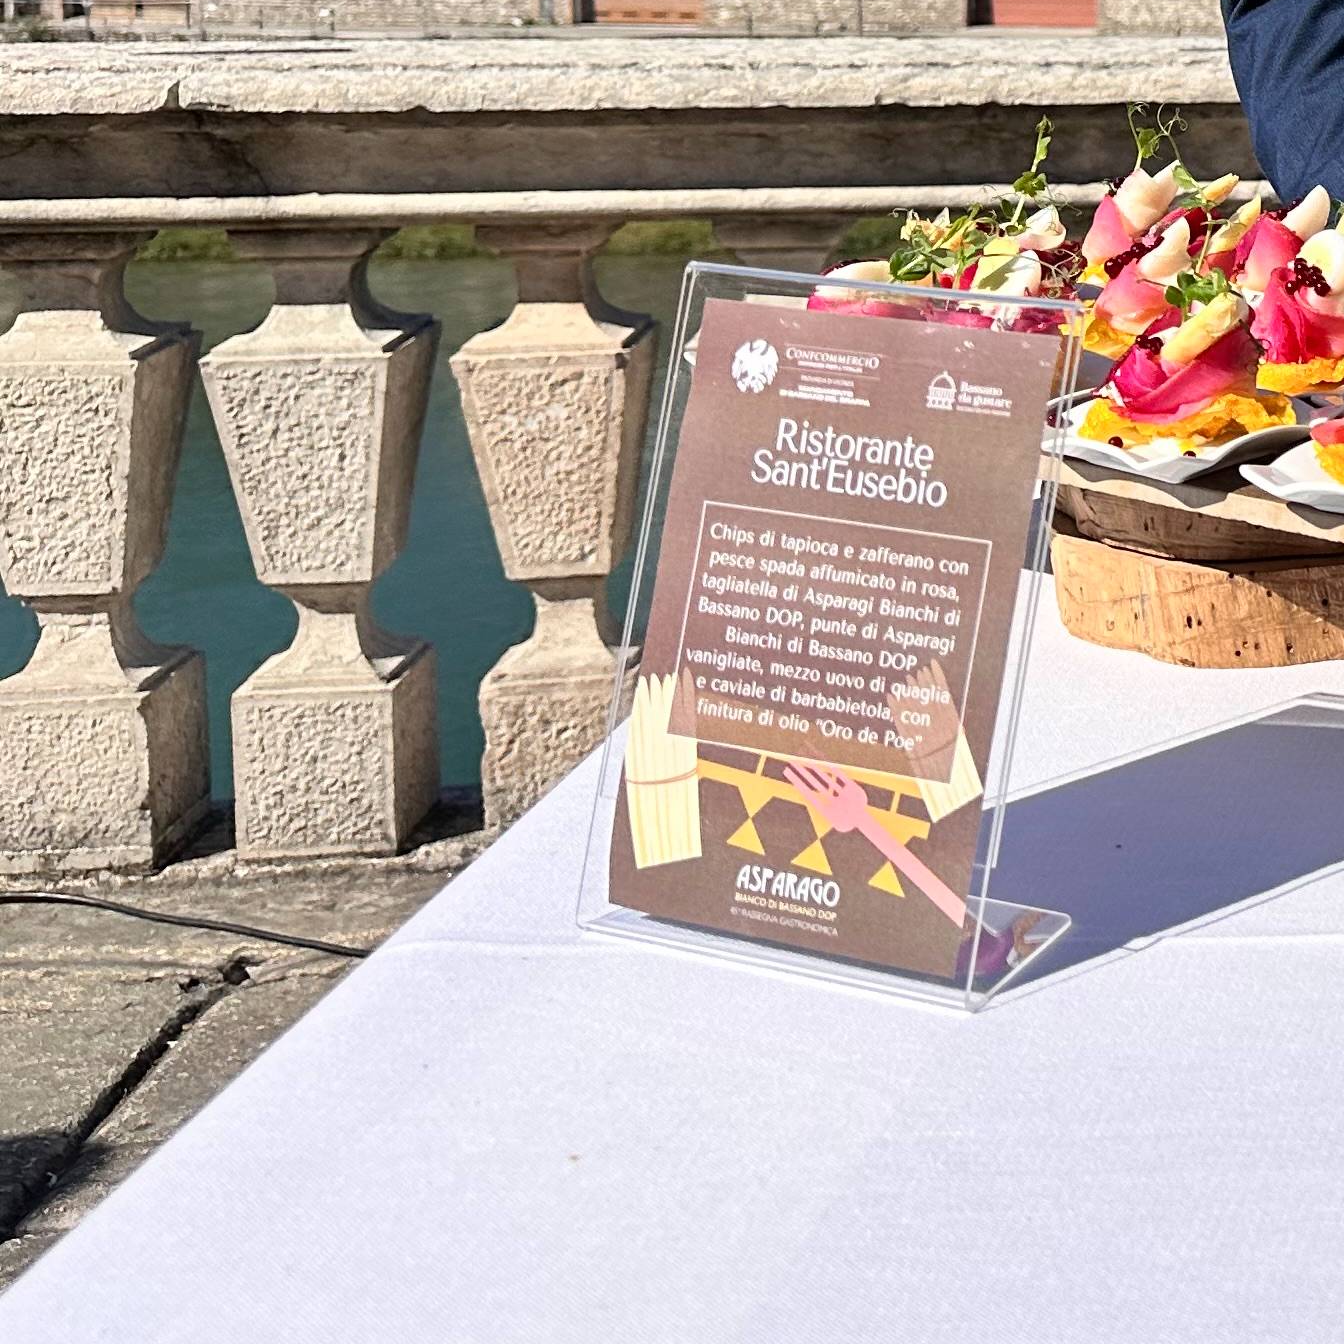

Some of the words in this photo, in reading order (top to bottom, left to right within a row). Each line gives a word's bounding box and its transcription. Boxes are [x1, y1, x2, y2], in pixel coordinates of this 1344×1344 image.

[785, 347, 880, 369] CONFCOMMERCIO
[957, 392, 972, 404] da
[972, 395, 1012, 409] gustare
[961, 381, 1003, 396] Bassano
[776, 417, 934, 470] Ristorante
[751, 449, 948, 508] Sant'Eusebio
[710, 522, 754, 546] Chips
[759, 530, 774, 547] di
[780, 533, 838, 556] tapioca
[843, 546, 854, 558] e
[859, 546, 934, 571] zafferano
[939, 558, 969, 576] con
[702, 572, 778, 599] tagliatella
[783, 584, 799, 601] di
[803, 587, 874, 616] Asparagi
[879, 599, 939, 623] Bianchi
[944, 610, 961, 627] di
[709, 552, 755, 569] pesce
[759, 556, 805, 578] spada
[810, 563, 895, 591] affumicato
[901, 576, 917, 594] in
[921, 581, 960, 602] rosa,
[698, 596, 760, 621] Bassano
[766, 607, 805, 631] DOP,
[810, 618, 856, 636] punte
[861, 623, 878, 640] di
[883, 627, 956, 654] Asparagi
[725, 626, 782, 650] Bianchi
[787, 637, 803, 653] di
[808, 640, 873, 665] Bassano
[878, 650, 917, 671] DOP
[686, 647, 764, 675] vanigliate,
[769, 661, 820, 682] mezzo
[825, 671, 865, 692] uovo
[870, 677, 885, 693] di
[891, 682, 950, 705] quaglia
[695, 675, 706, 689] e
[711, 678, 765, 699] caviale
[770, 685, 786, 702] di
[791, 689, 894, 723] barbabietola,
[900, 709, 931, 727] con
[697, 699, 753, 723] finitura
[758, 709, 774, 726] di
[778, 713, 809, 732] olio
[816, 718, 852, 739] "Oro
[858, 726, 878, 744] de
[884, 731, 923, 751] Poe"
[735, 892, 766, 906] BIANCO
[779, 901, 816, 917] BASSANO
[818, 909, 837, 922] DOP
[736, 864, 840, 908] ASPARAGO
[779, 916, 838, 936] GASTRONOMICA
